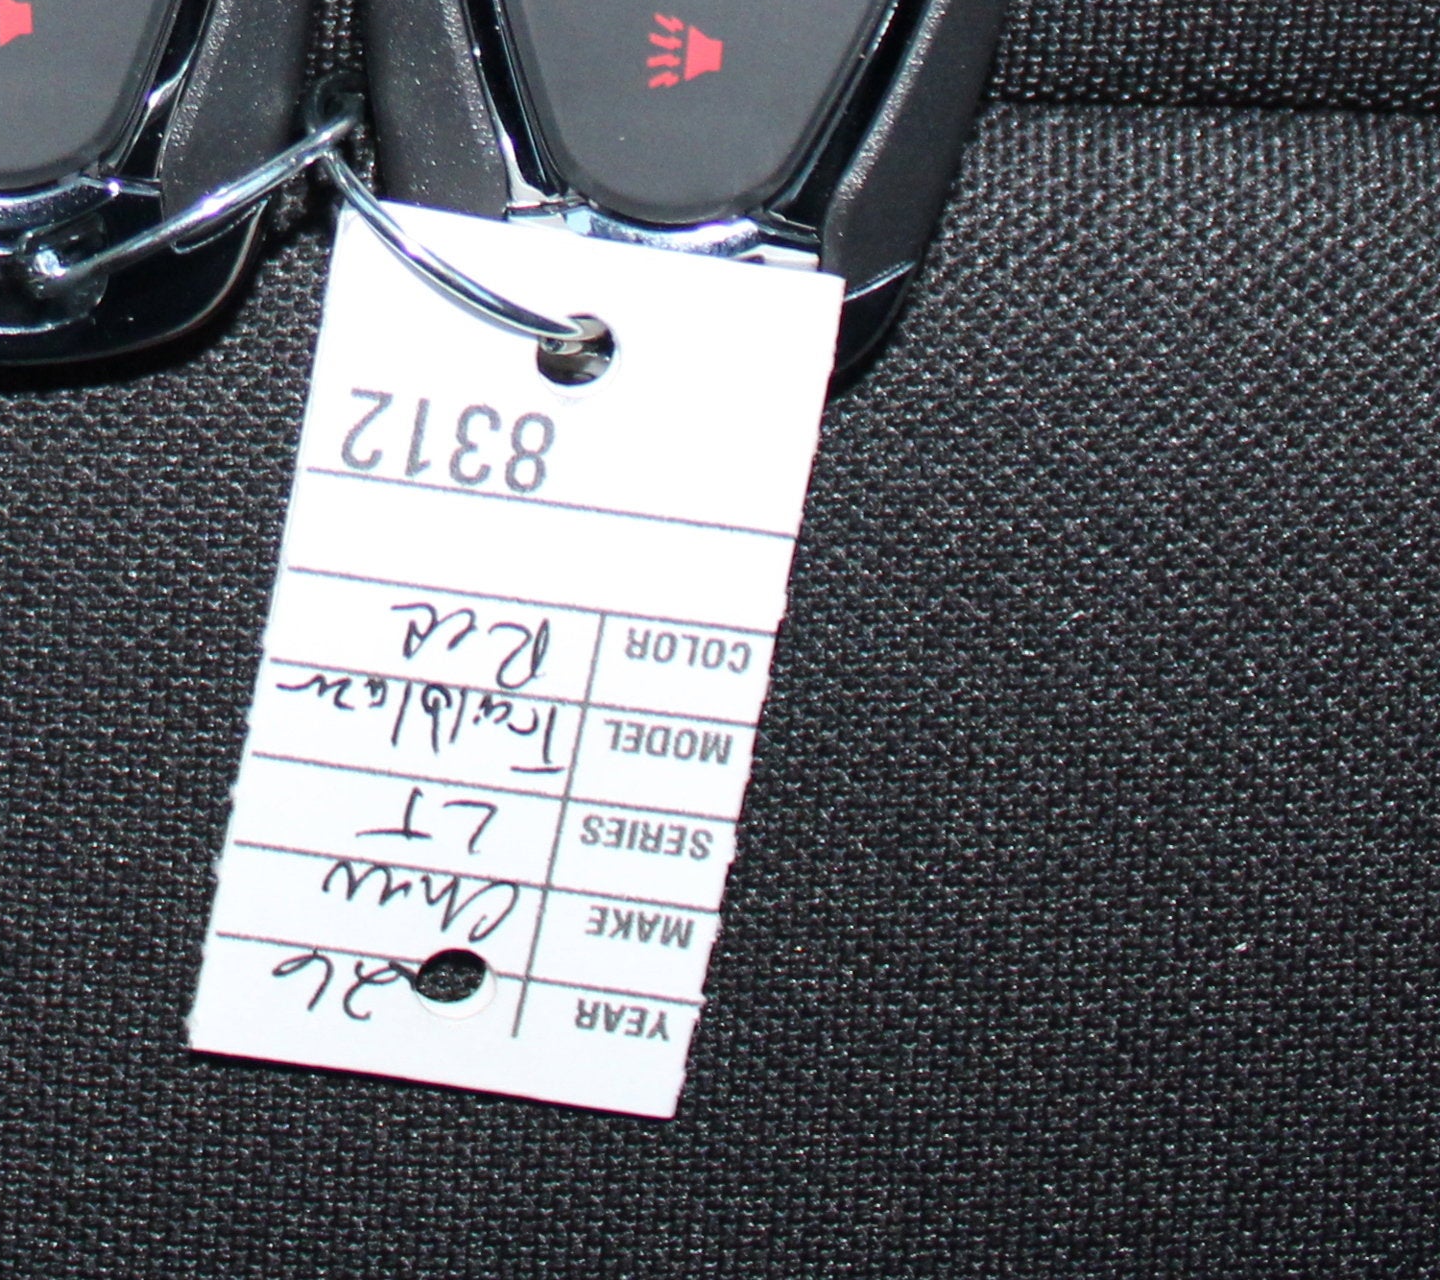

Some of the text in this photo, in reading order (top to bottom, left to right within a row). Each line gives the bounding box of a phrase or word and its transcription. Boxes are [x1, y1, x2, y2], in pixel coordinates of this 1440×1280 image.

[340, 387, 556, 494] 8312
[390, 602, 549, 688] Red
[625, 627, 752, 674] COLOR
[603, 718, 734, 765] MODEL
[355, 787, 497, 854] LT
[580, 814, 714, 860] SERIES
[585, 905, 695, 949] MAKE
[574, 999, 670, 1043] YEAR
